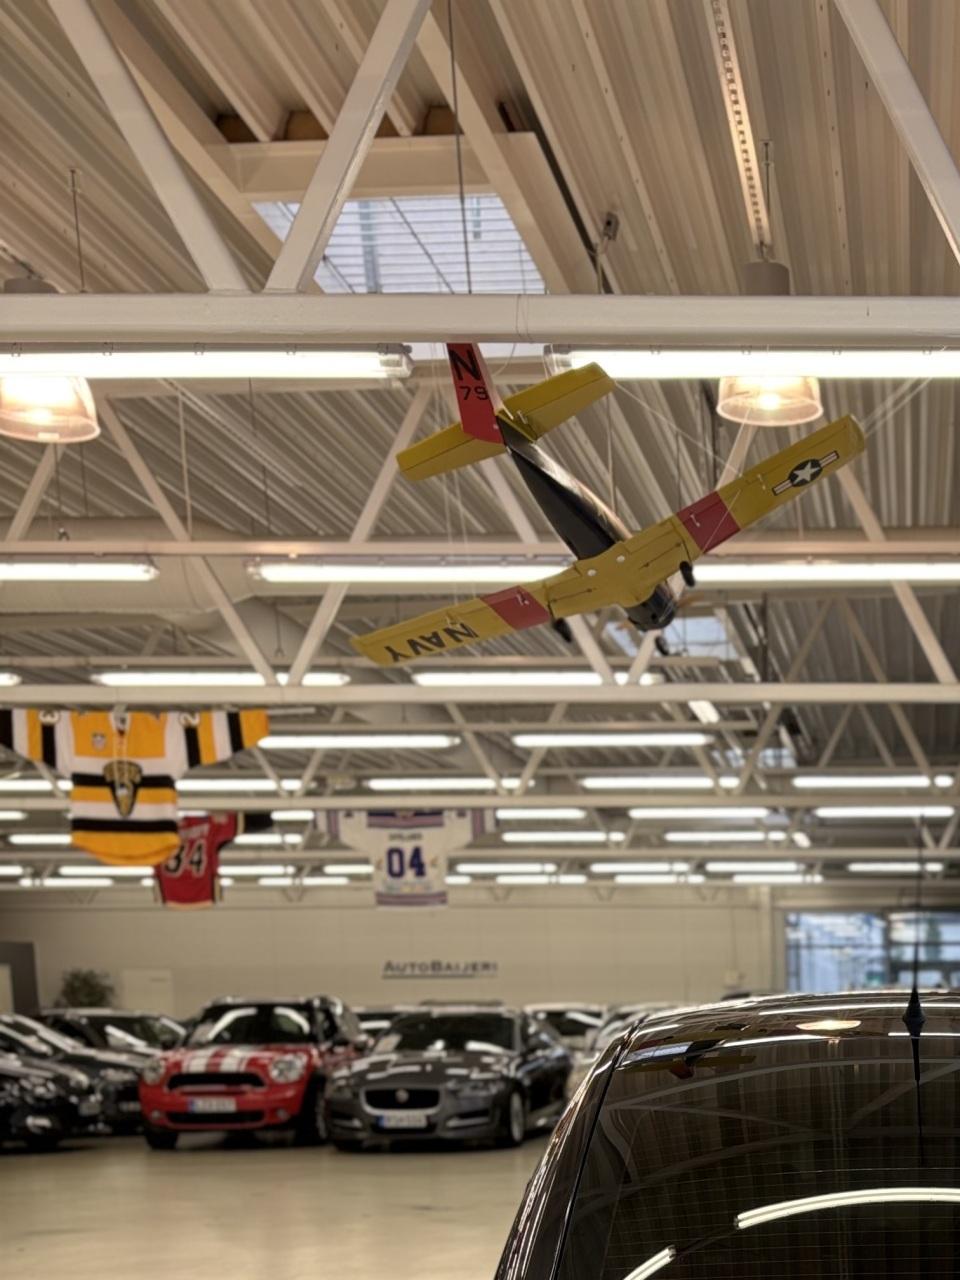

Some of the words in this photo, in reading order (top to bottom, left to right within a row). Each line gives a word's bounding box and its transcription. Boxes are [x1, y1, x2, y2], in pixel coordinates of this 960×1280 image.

[449, 349, 481, 381] N
[384, 622, 479, 663] NAVY
[386, 846, 426, 878] 04
